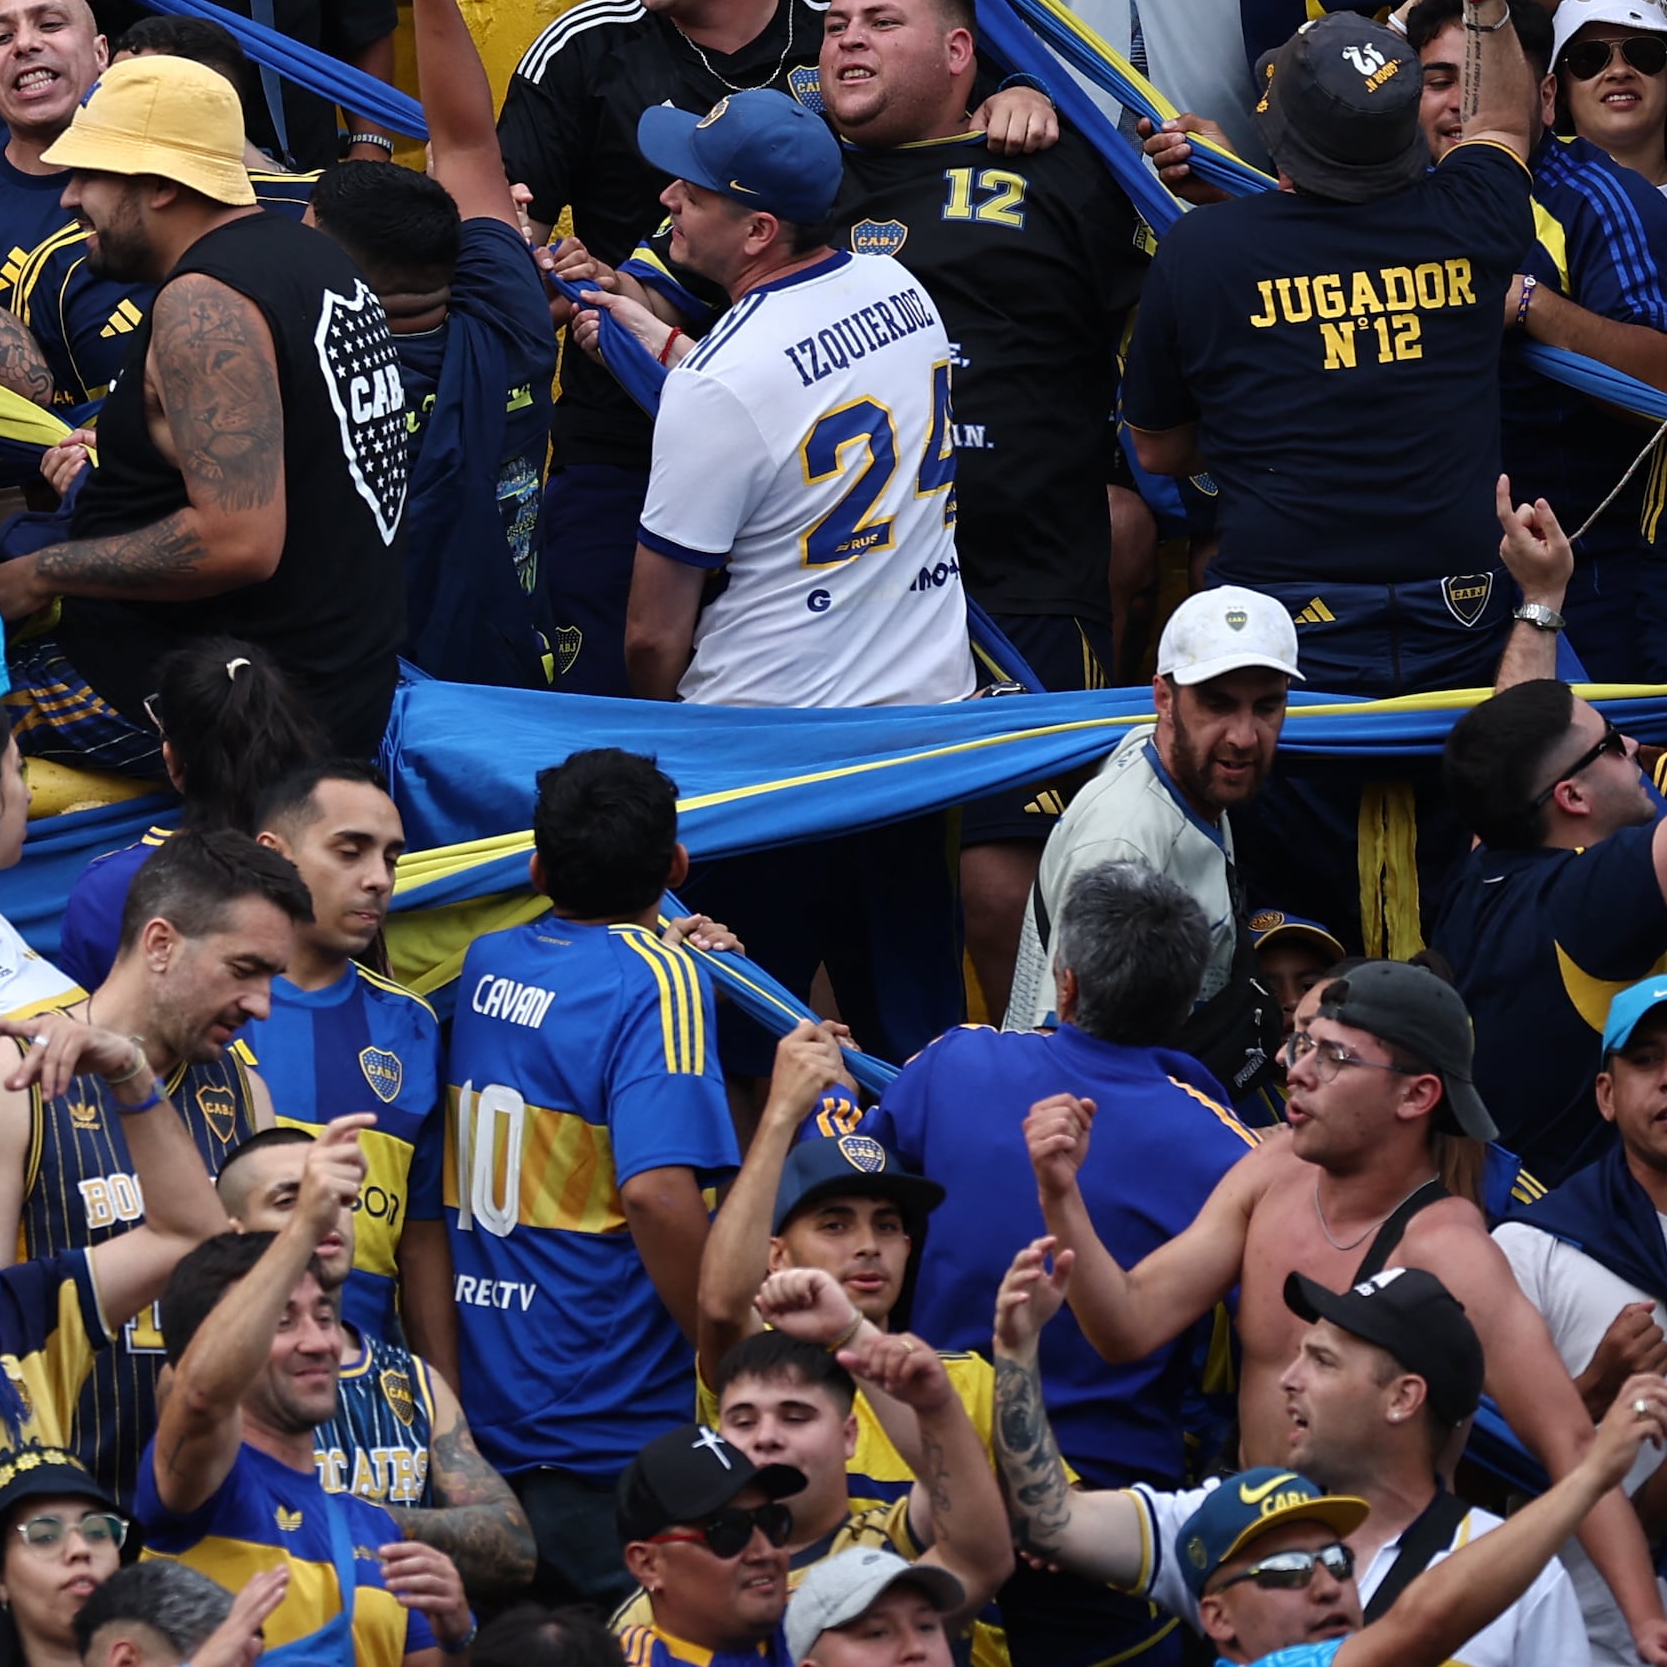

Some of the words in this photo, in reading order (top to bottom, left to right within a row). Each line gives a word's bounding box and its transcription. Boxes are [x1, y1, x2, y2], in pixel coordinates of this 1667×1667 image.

[796, 81, 820, 93] CAB
[940, 166, 1028, 230] 12
[857, 235, 899, 248] CABJ
[1250, 258, 1478, 330] JUGADOR
[783, 288, 935, 387] IZQUIERDOZ
[350, 365, 405, 424] CAB
[799, 360, 956, 569] 24
[851, 533, 879, 550] RUS
[1454, 587, 1484, 599] CABJ
[558, 642, 577, 654] ABJ
[471, 974, 556, 1029] CAVANI
[367, 1064, 398, 1082] CABJ
[456, 1079, 526, 1239] 10
[847, 1146, 882, 1161] CABJ
[454, 1273, 537, 1312] RECTV
